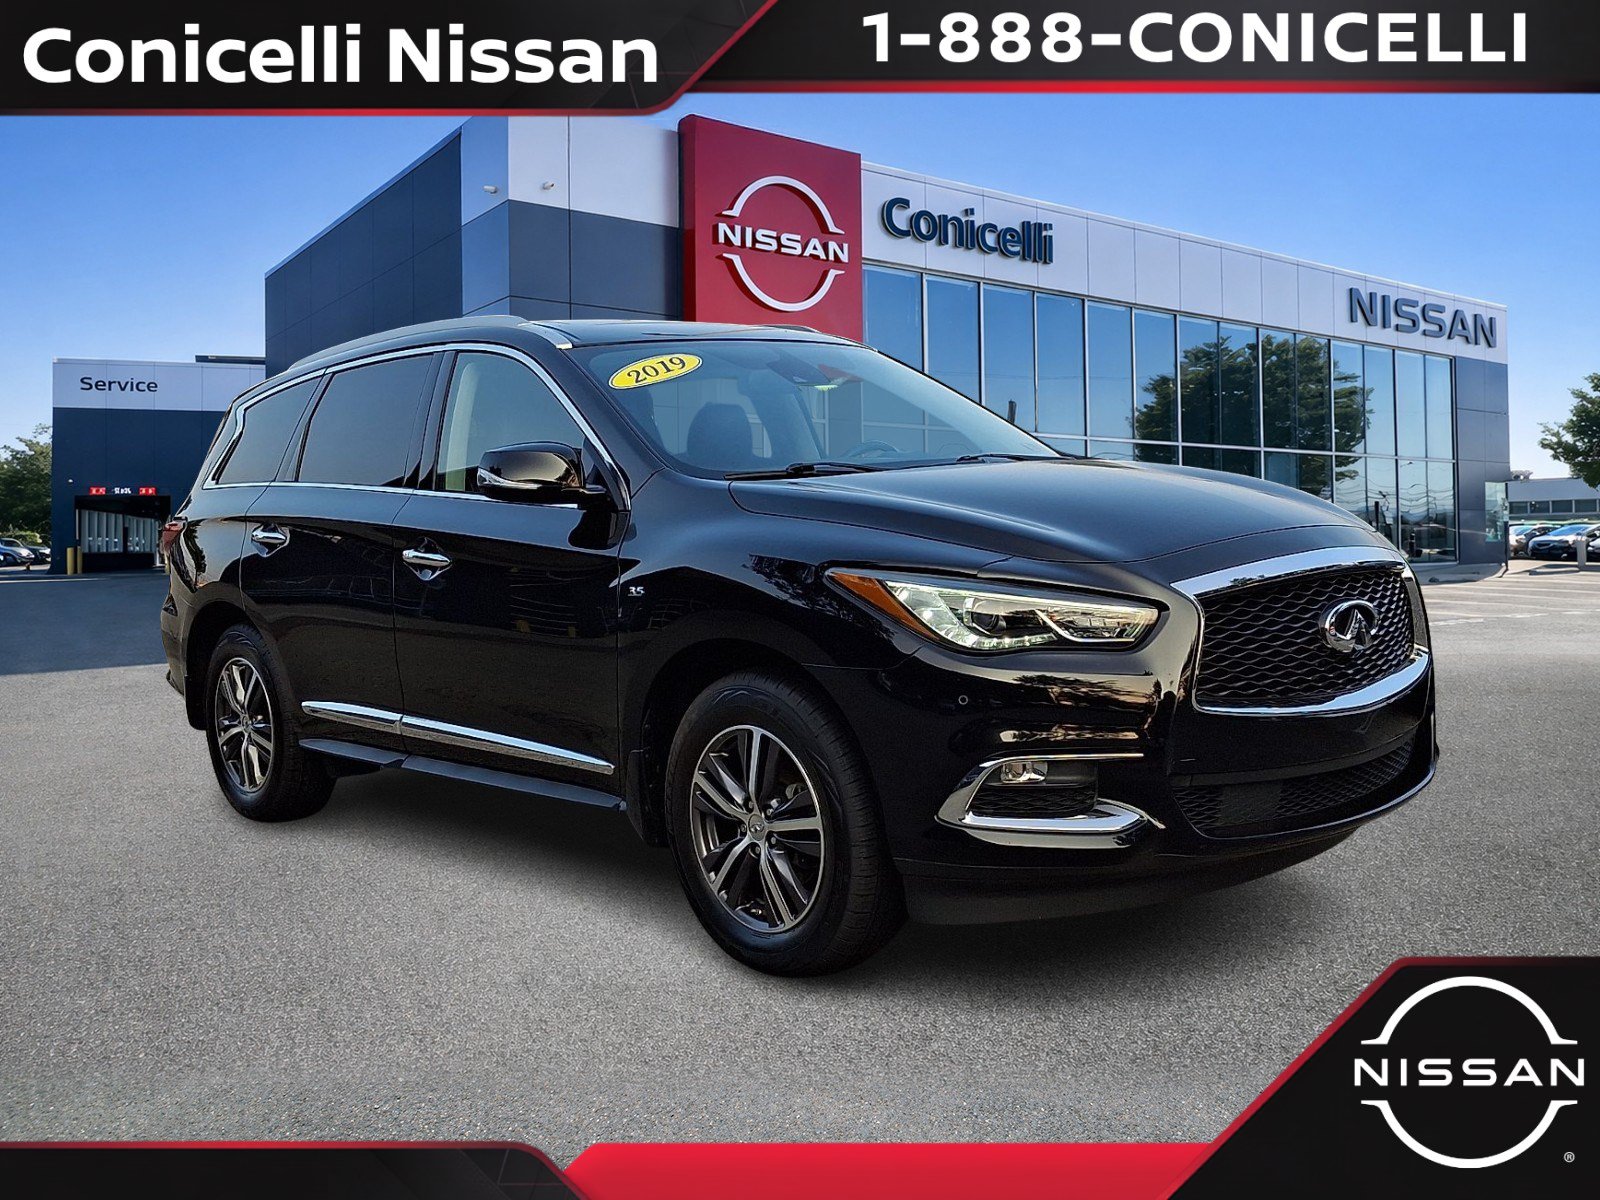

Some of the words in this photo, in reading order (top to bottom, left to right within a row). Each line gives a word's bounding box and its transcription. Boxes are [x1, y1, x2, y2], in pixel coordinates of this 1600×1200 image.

[716, 222, 849, 264] NISSAN
[882, 197, 1054, 264] Conicelli
[1348, 287, 1497, 348] NISSAN
[79, 376, 158, 393] Service
[626, 356, 687, 384] 2019
